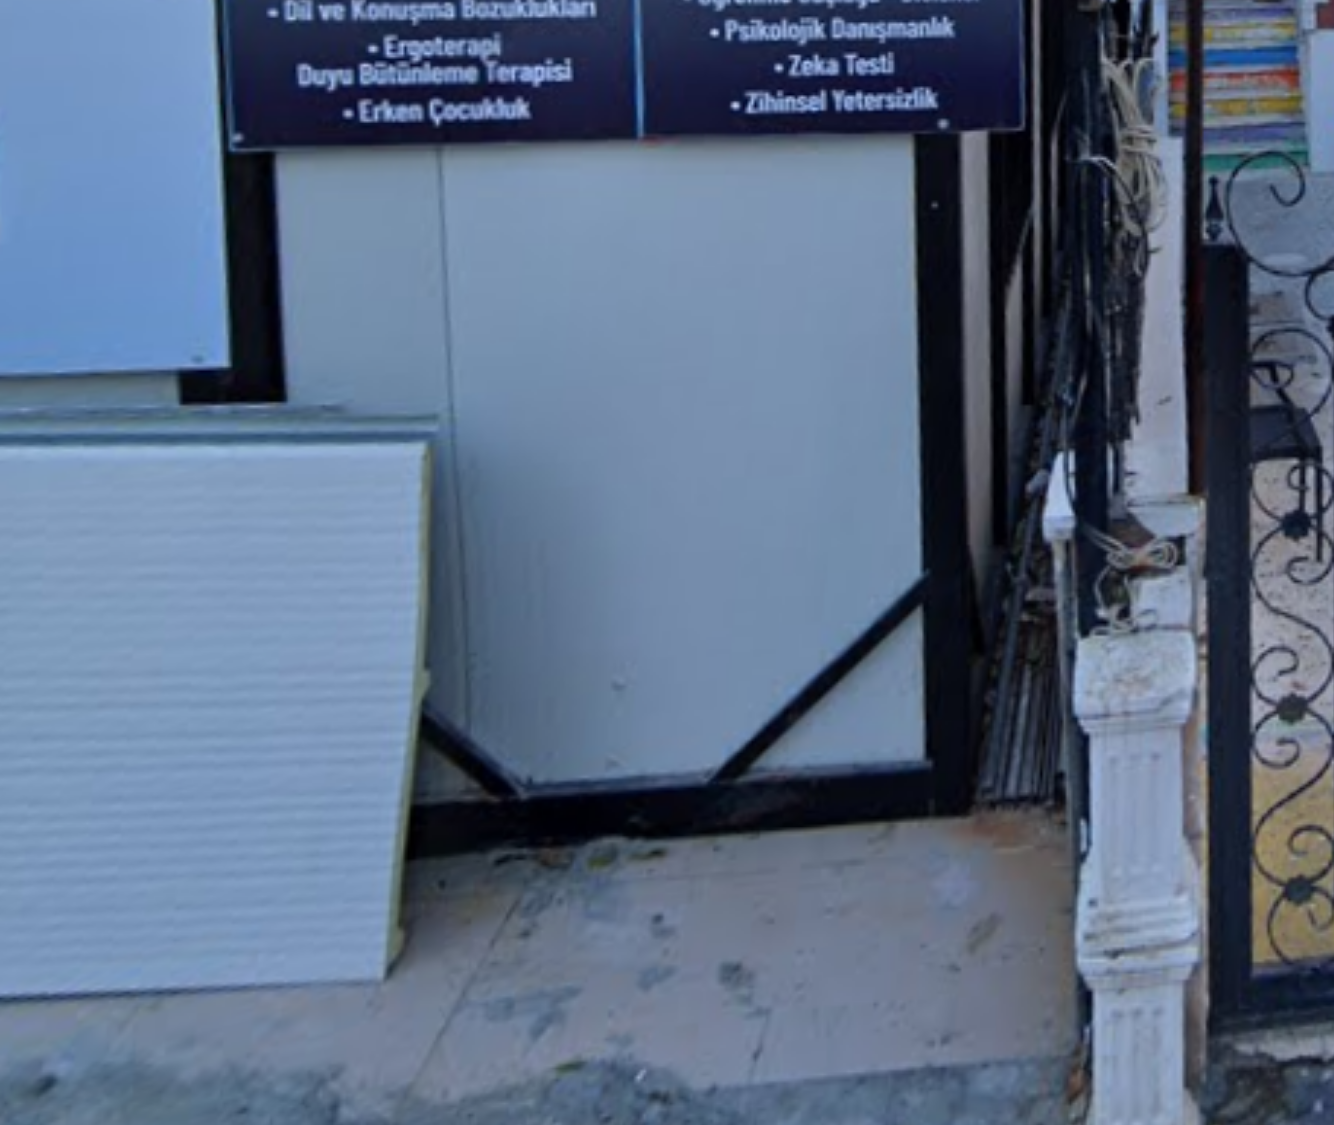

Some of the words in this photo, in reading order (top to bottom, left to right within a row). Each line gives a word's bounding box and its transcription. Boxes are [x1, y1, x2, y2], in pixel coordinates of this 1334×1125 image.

[283, 0, 314, 22] Dil
[319, 4, 346, 21] ve
[724, 17, 826, 47] Psikolojik
[831, 16, 956, 44] Danışmanlık
[383, 32, 502, 63] Ergoterapi
[296, 63, 353, 92] Duyu
[358, 60, 480, 86] Bütünleme
[485, 57, 574, 87] Terapisi
[788, 54, 840, 78] Zeka
[843, 51, 895, 75] Testi
[358, 99, 424, 124] Erken
[428, 96, 532, 127] Çocukluk
[744, 88, 828, 116] Zihinsel
[832, 86, 939, 114] Yetersizlik
